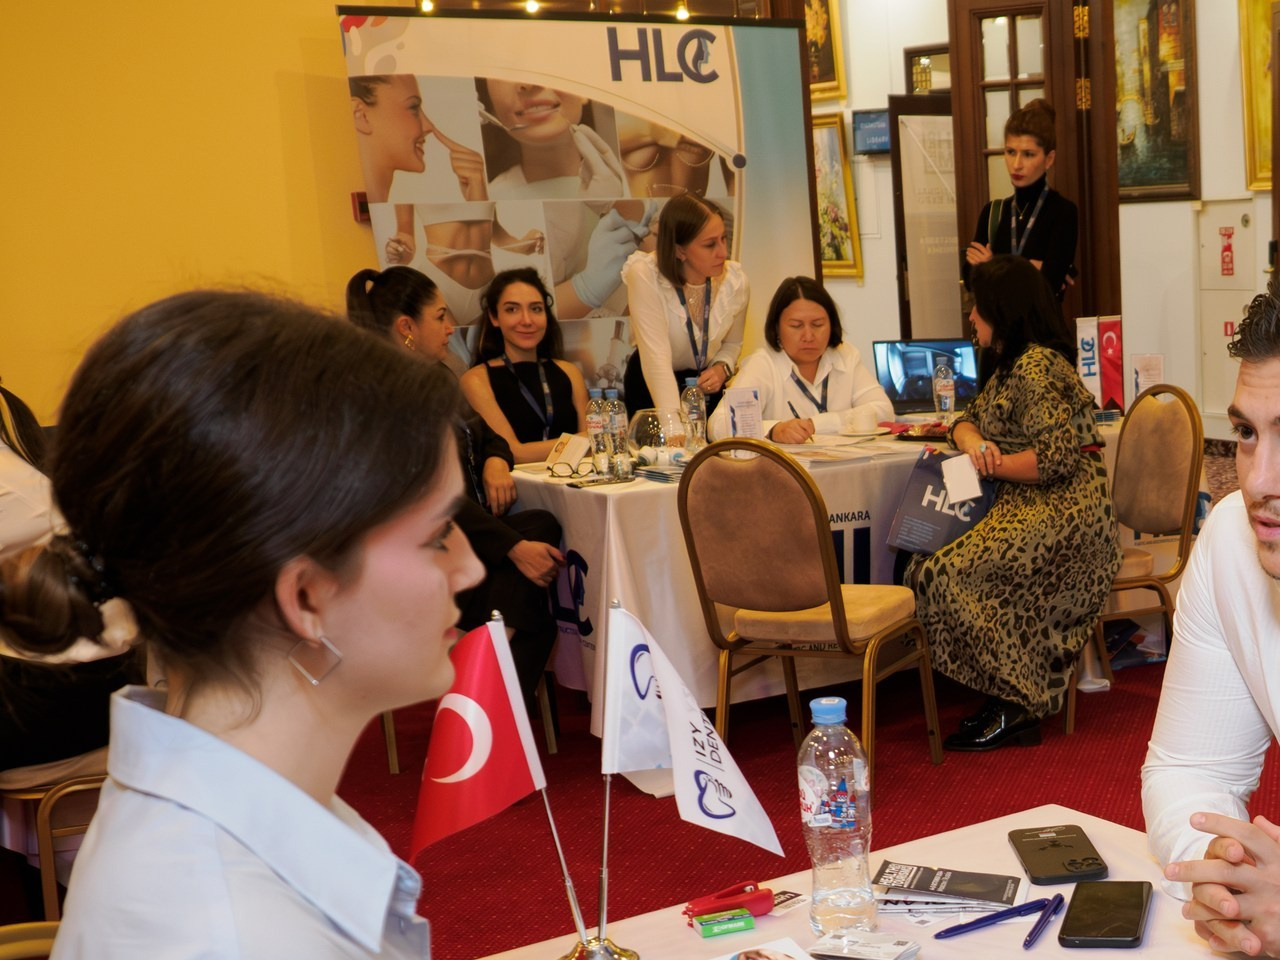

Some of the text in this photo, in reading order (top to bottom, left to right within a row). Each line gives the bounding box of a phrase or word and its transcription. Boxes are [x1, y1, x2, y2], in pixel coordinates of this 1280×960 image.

[606, 26, 720, 84] HLC
[1081, 336, 1097, 378] HLC
[829, 510, 871, 525] ANKARA
[689, 721, 707, 758] IZY
